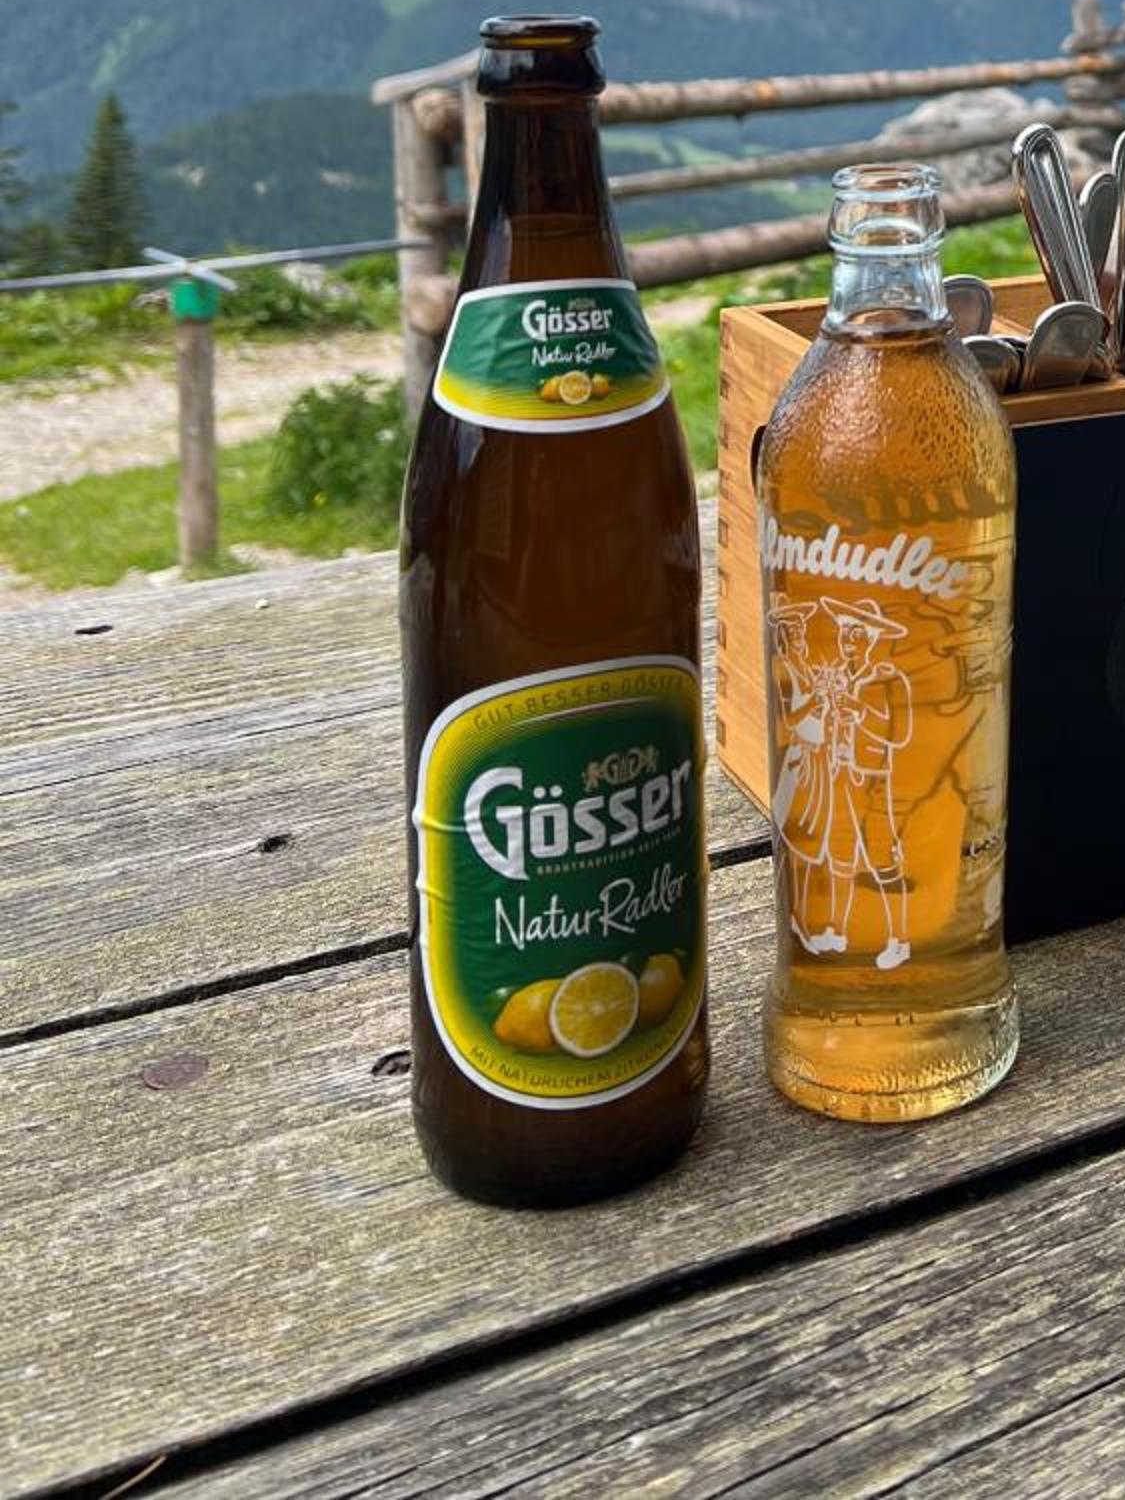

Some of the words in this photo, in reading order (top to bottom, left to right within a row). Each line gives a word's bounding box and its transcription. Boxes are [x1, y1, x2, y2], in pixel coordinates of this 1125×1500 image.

[521, 299, 613, 341] Gösser
[762, 517, 969, 598] lmdudler
[474, 703, 515, 731] GUT
[527, 683, 610, 715] BESSER
[464, 760, 692, 880] Gösser
